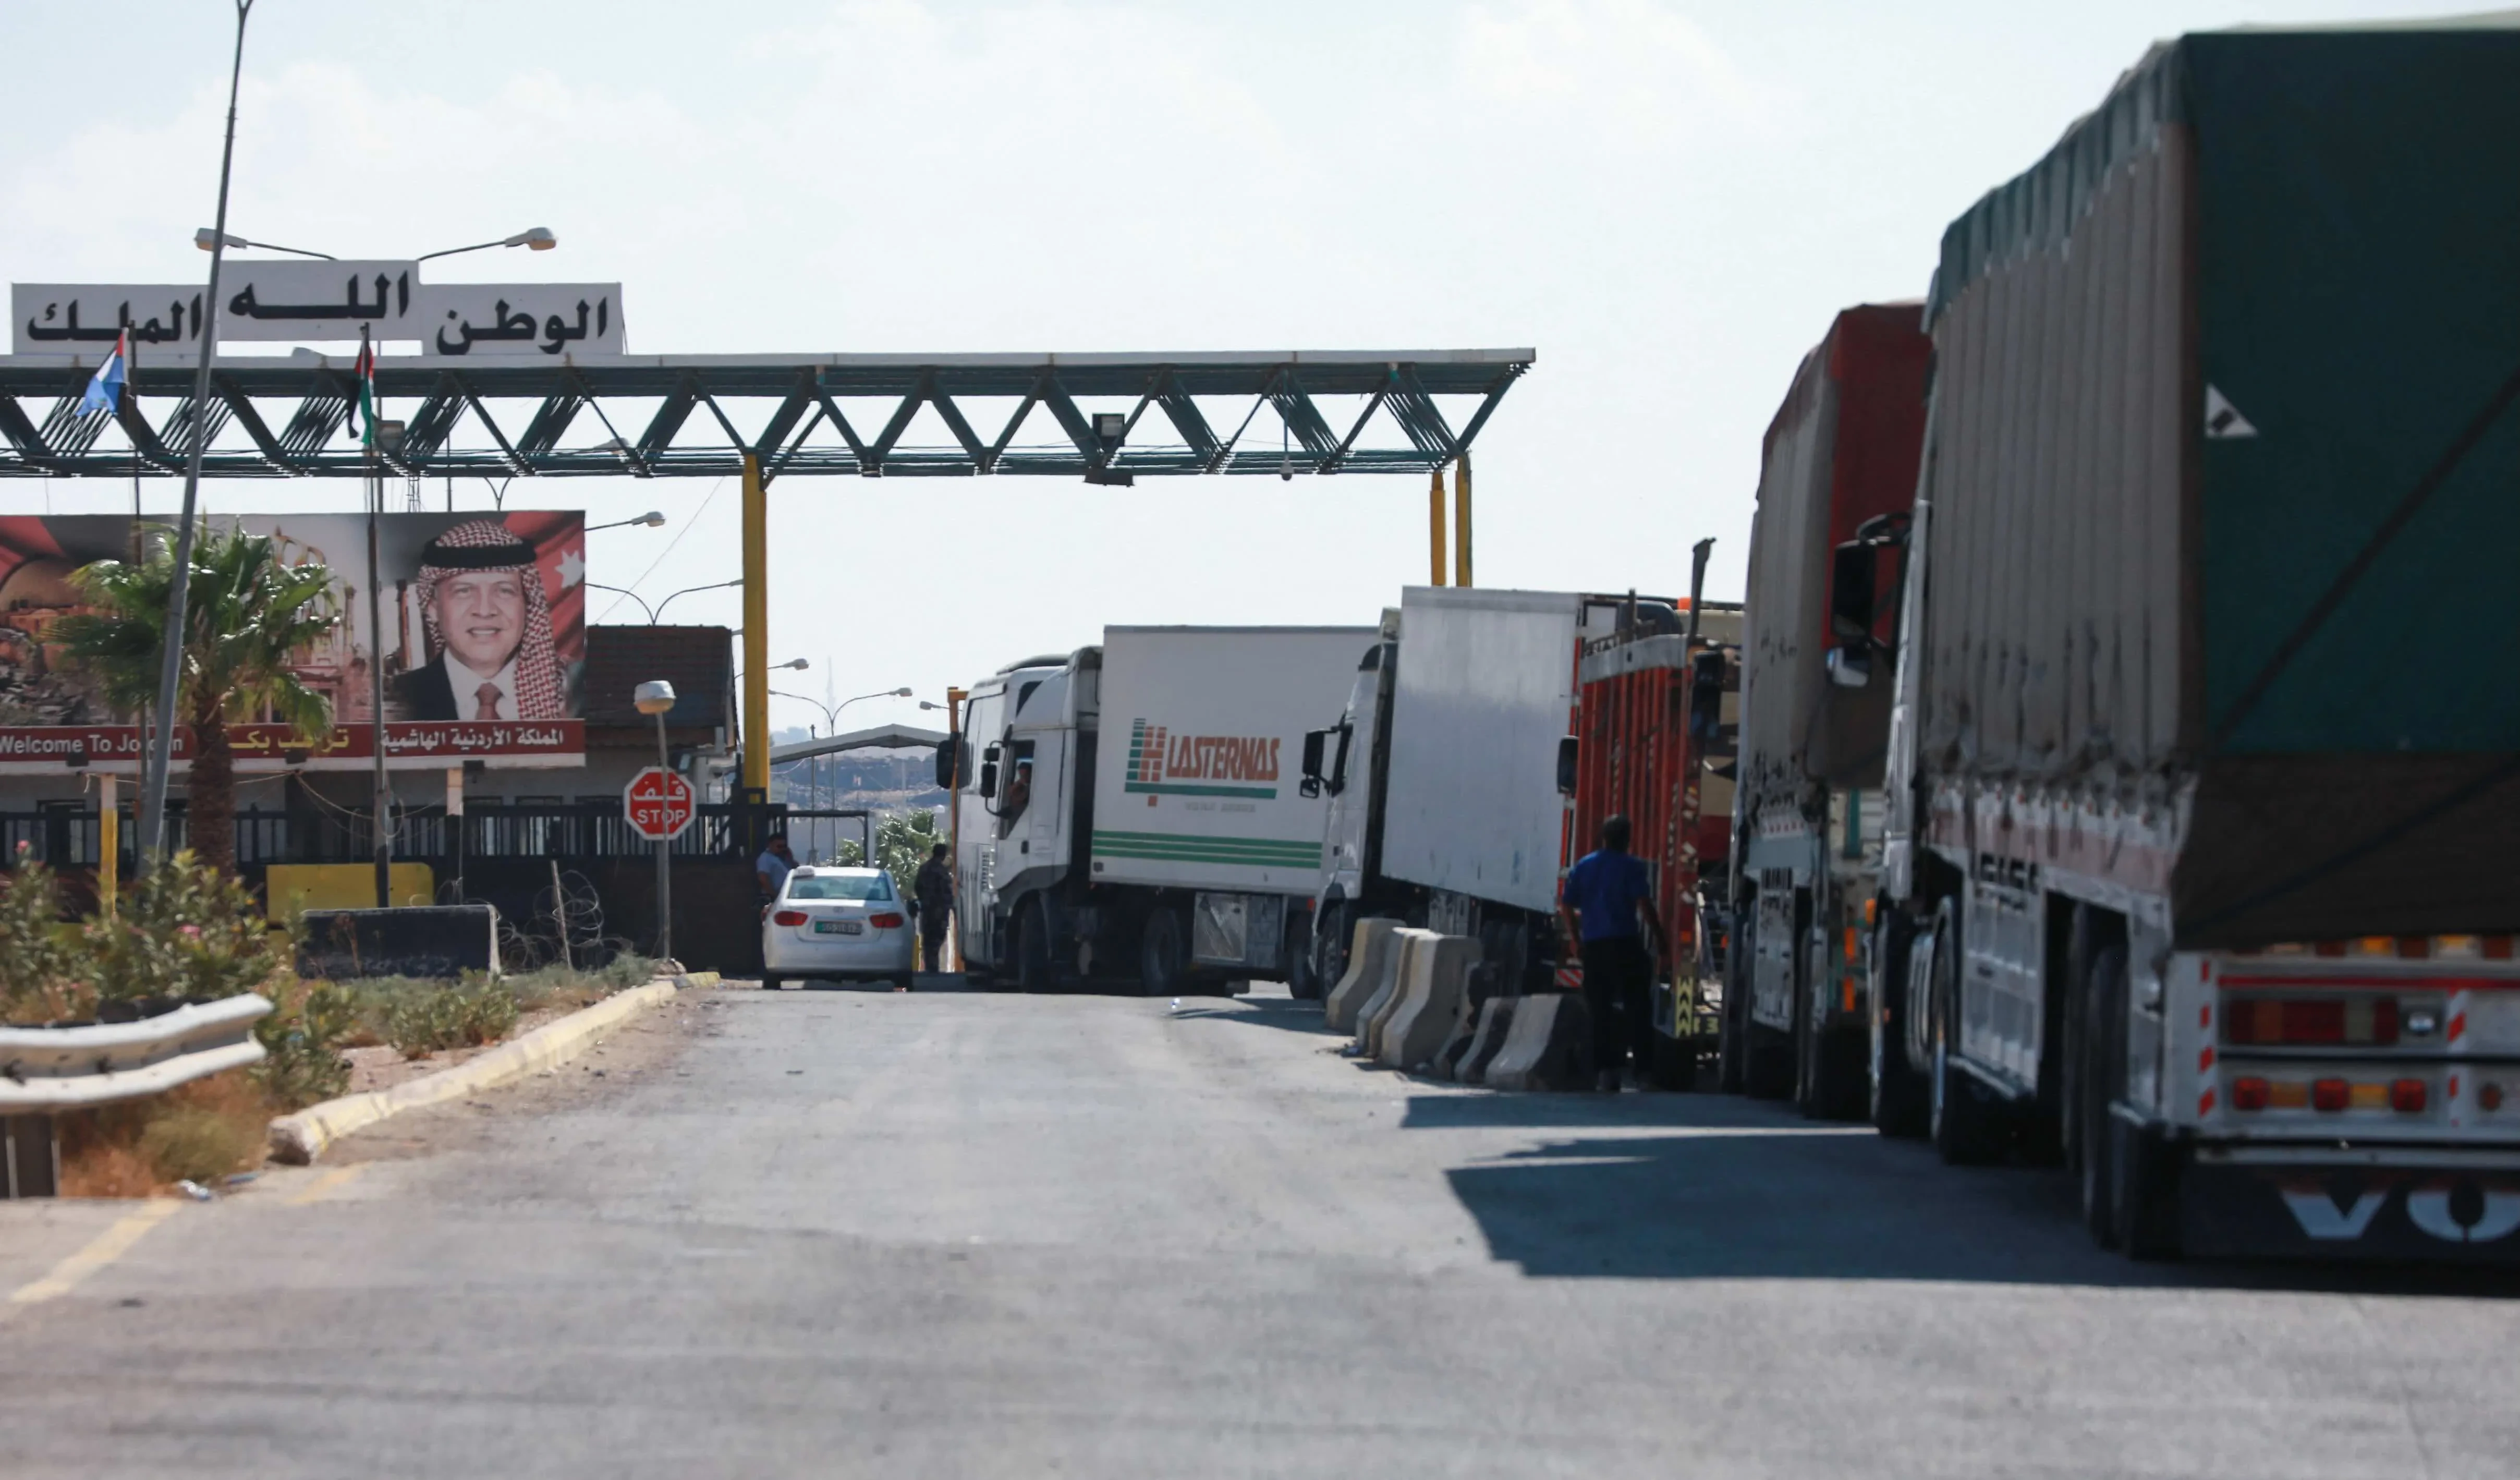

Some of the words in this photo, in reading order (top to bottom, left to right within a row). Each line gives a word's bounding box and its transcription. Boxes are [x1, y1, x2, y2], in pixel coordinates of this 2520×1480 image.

[229, 270, 409, 319] الله
[28, 293, 202, 344] الملك
[436, 297, 607, 355] الوطن
[0, 735, 83, 754] Welcome
[88, 734, 112, 753] To
[380, 729, 446, 752] الهاشمية
[515, 726, 564, 746] المملكة
[1166, 735, 1281, 781] LASTERNAS
[637, 809, 687, 824] STOP
